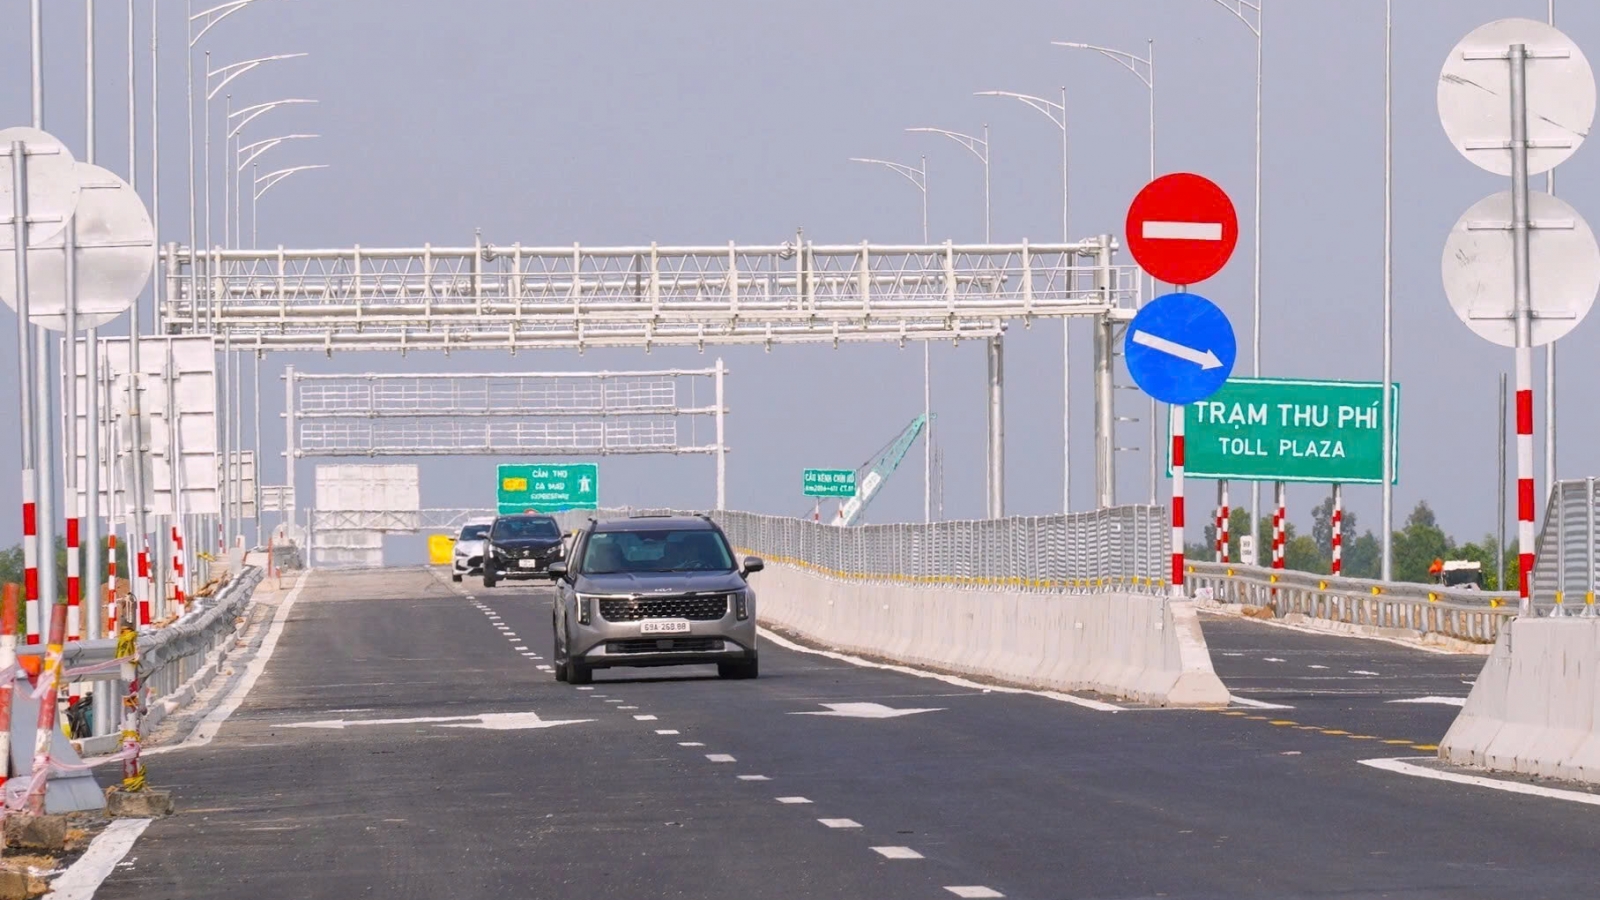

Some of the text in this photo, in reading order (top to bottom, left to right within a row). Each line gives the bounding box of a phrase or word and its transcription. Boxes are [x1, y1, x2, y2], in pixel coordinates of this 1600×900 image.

[1193, 400, 1380, 430] TRẠM THU PHÍ
[1219, 437, 1346, 458] TOLL PLAZA
